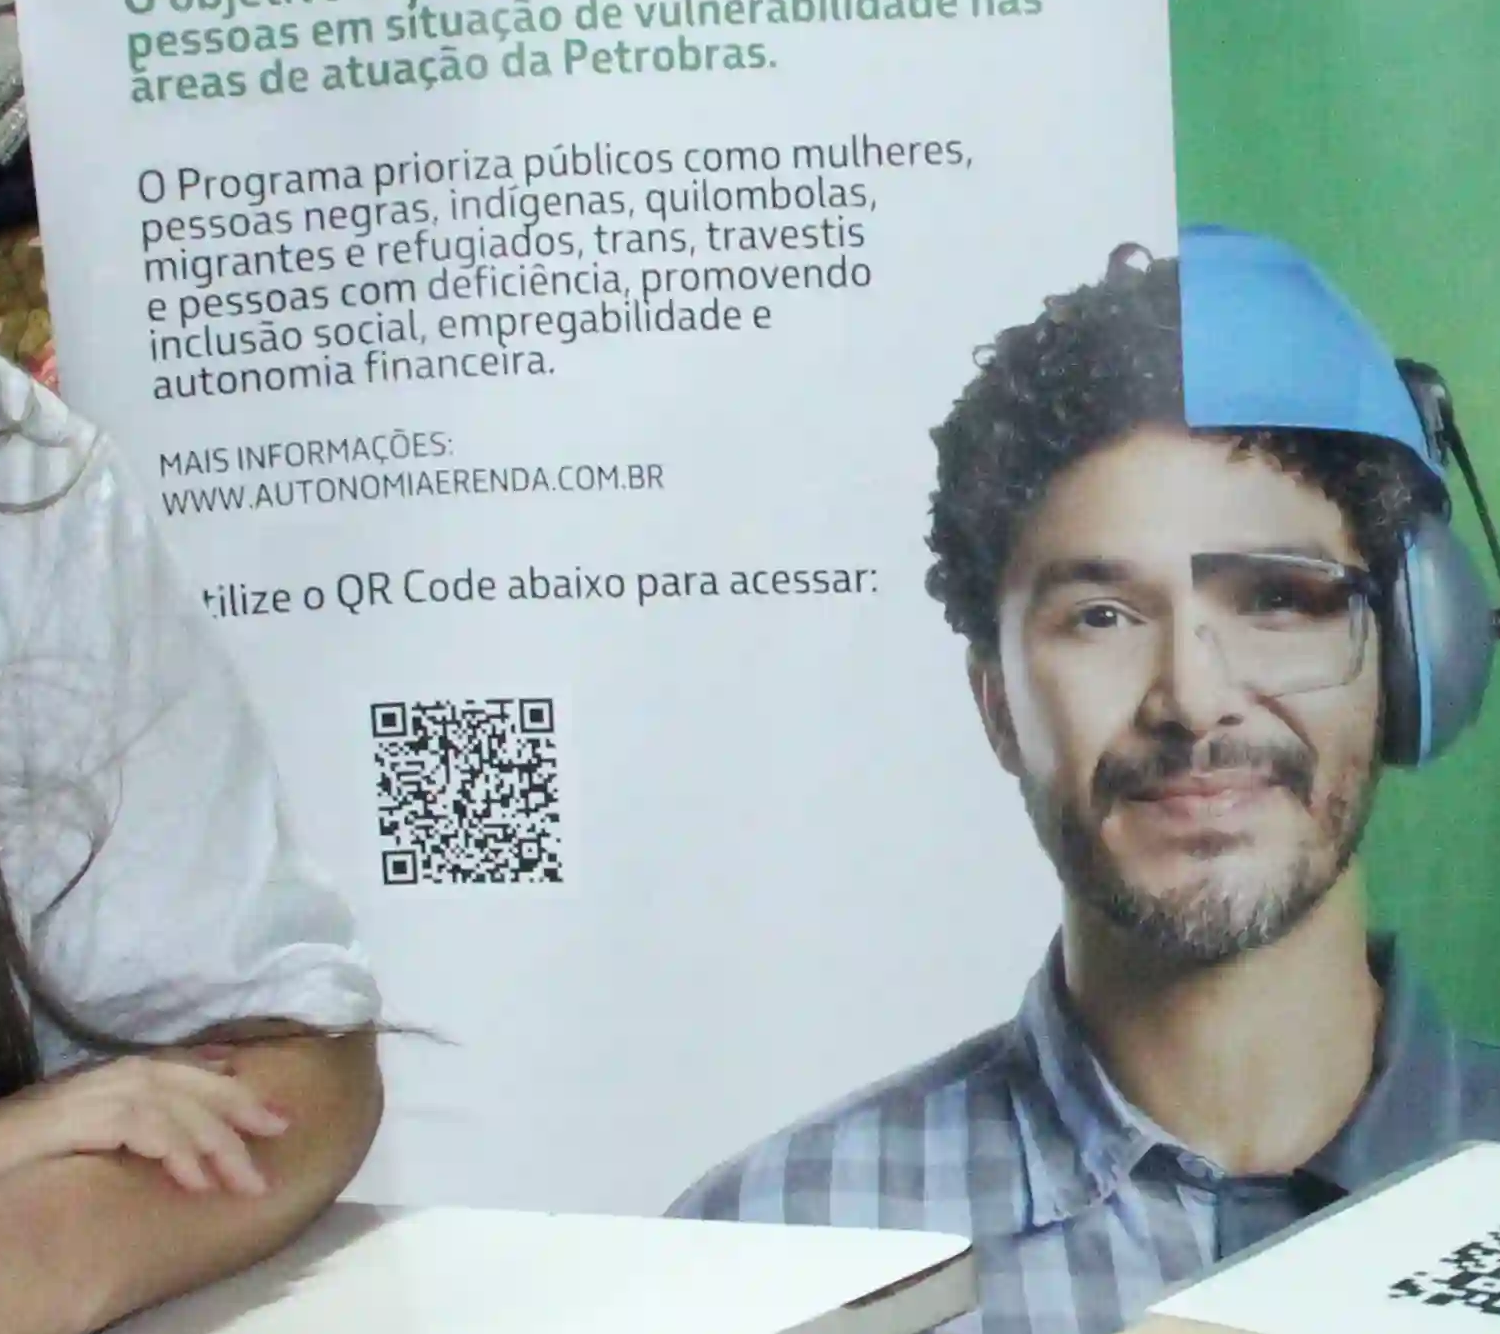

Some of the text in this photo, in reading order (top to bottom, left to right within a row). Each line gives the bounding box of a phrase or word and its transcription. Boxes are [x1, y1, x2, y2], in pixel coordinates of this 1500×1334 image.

[129, 23, 298, 64] pessoas
[313, 18, 373, 46] em
[132, 35, 776, 103] áreas de atuação da Petrobras.
[139, 133, 971, 206] O Programa prioriza públicos como mulheres,
[142, 210, 292, 246] pessoas
[452, 188, 634, 227] indígenas,
[646, 175, 875, 223] quilombolas,
[145, 218, 864, 289] migrantes e refugiados, trans, travestis
[148, 254, 871, 329] e pessoas com deficiência, promovendo
[150, 297, 771, 361] inclusão social, empregabilidade e
[154, 350, 554, 400] autonomia financeira.
[160, 429, 454, 477] MAIS INFORMAÇÕES:
[162, 464, 663, 516] WWW.AUTONOMIAERENDA.COM.BR
[203, 566, 877, 617] tilize o QR Code abaixo para acessar:
